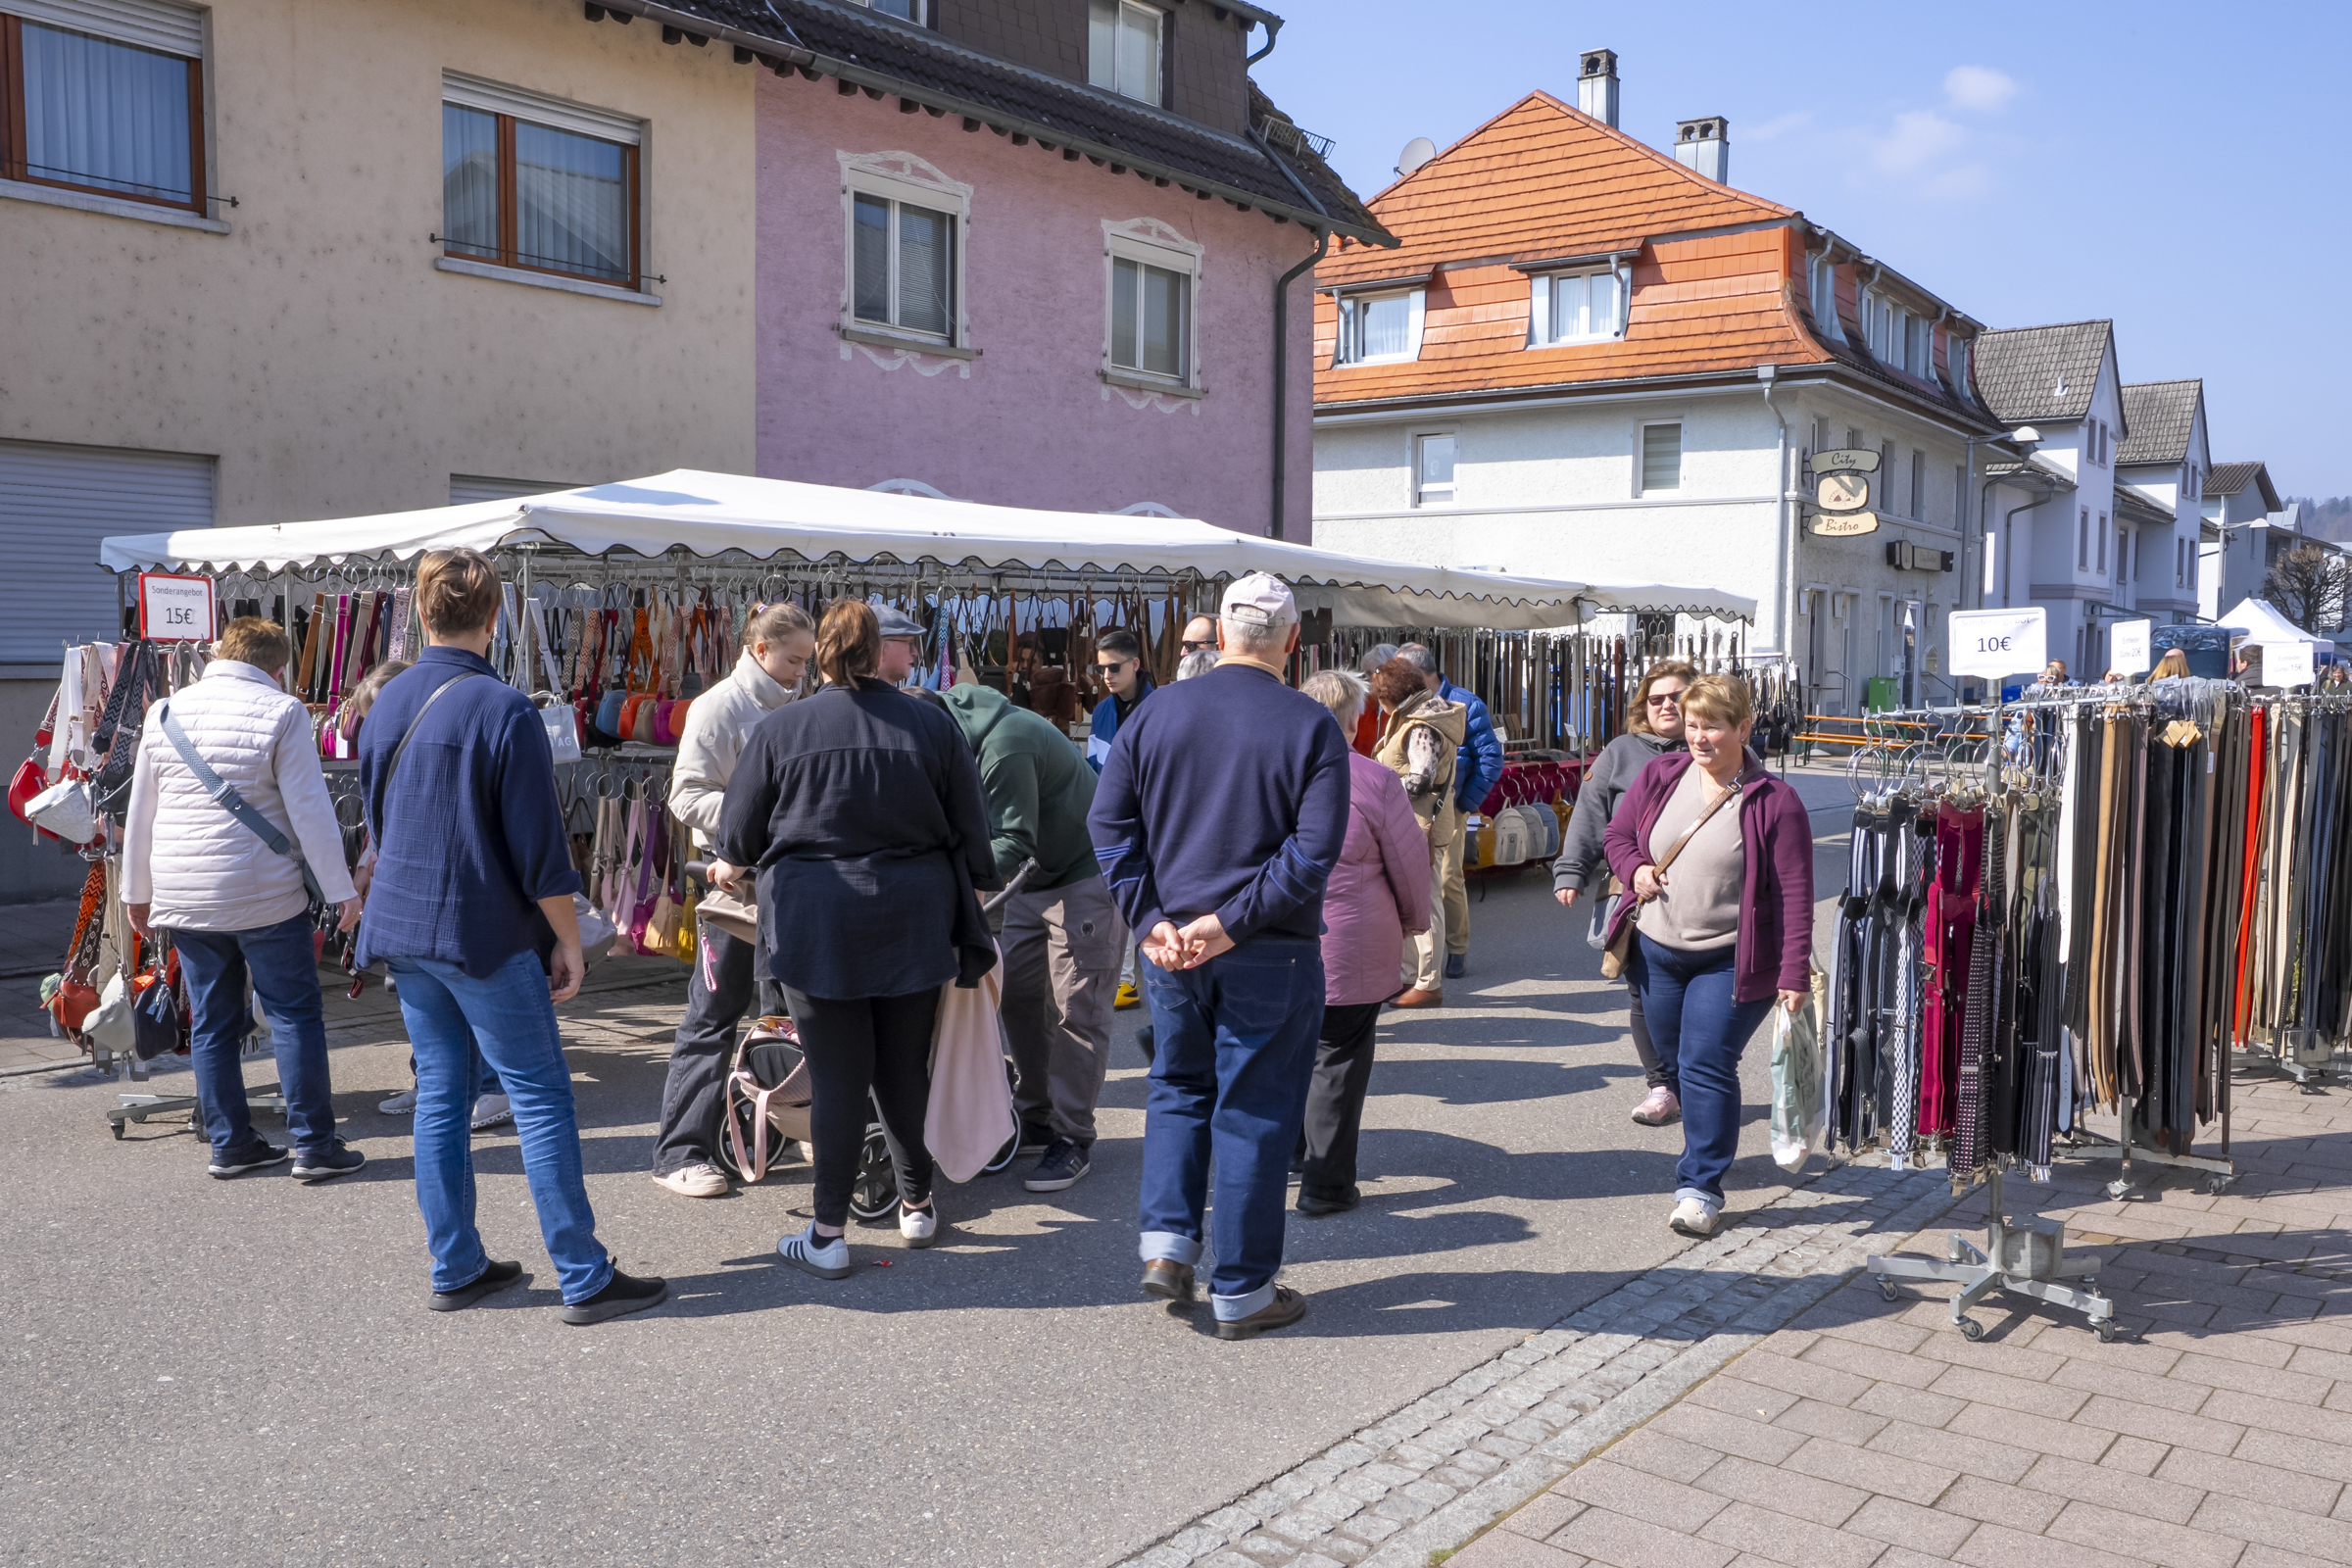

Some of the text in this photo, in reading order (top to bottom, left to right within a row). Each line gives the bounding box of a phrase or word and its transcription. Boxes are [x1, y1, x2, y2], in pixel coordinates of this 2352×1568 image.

[1832, 453, 1856, 468] City
[1825, 518, 1859, 531] Bistro
[152, 586, 203, 597] Sonderangebot
[166, 608, 193, 624] 15€
[1978, 636, 2012, 652] 10€
[2290, 662, 2303, 671] 15€
